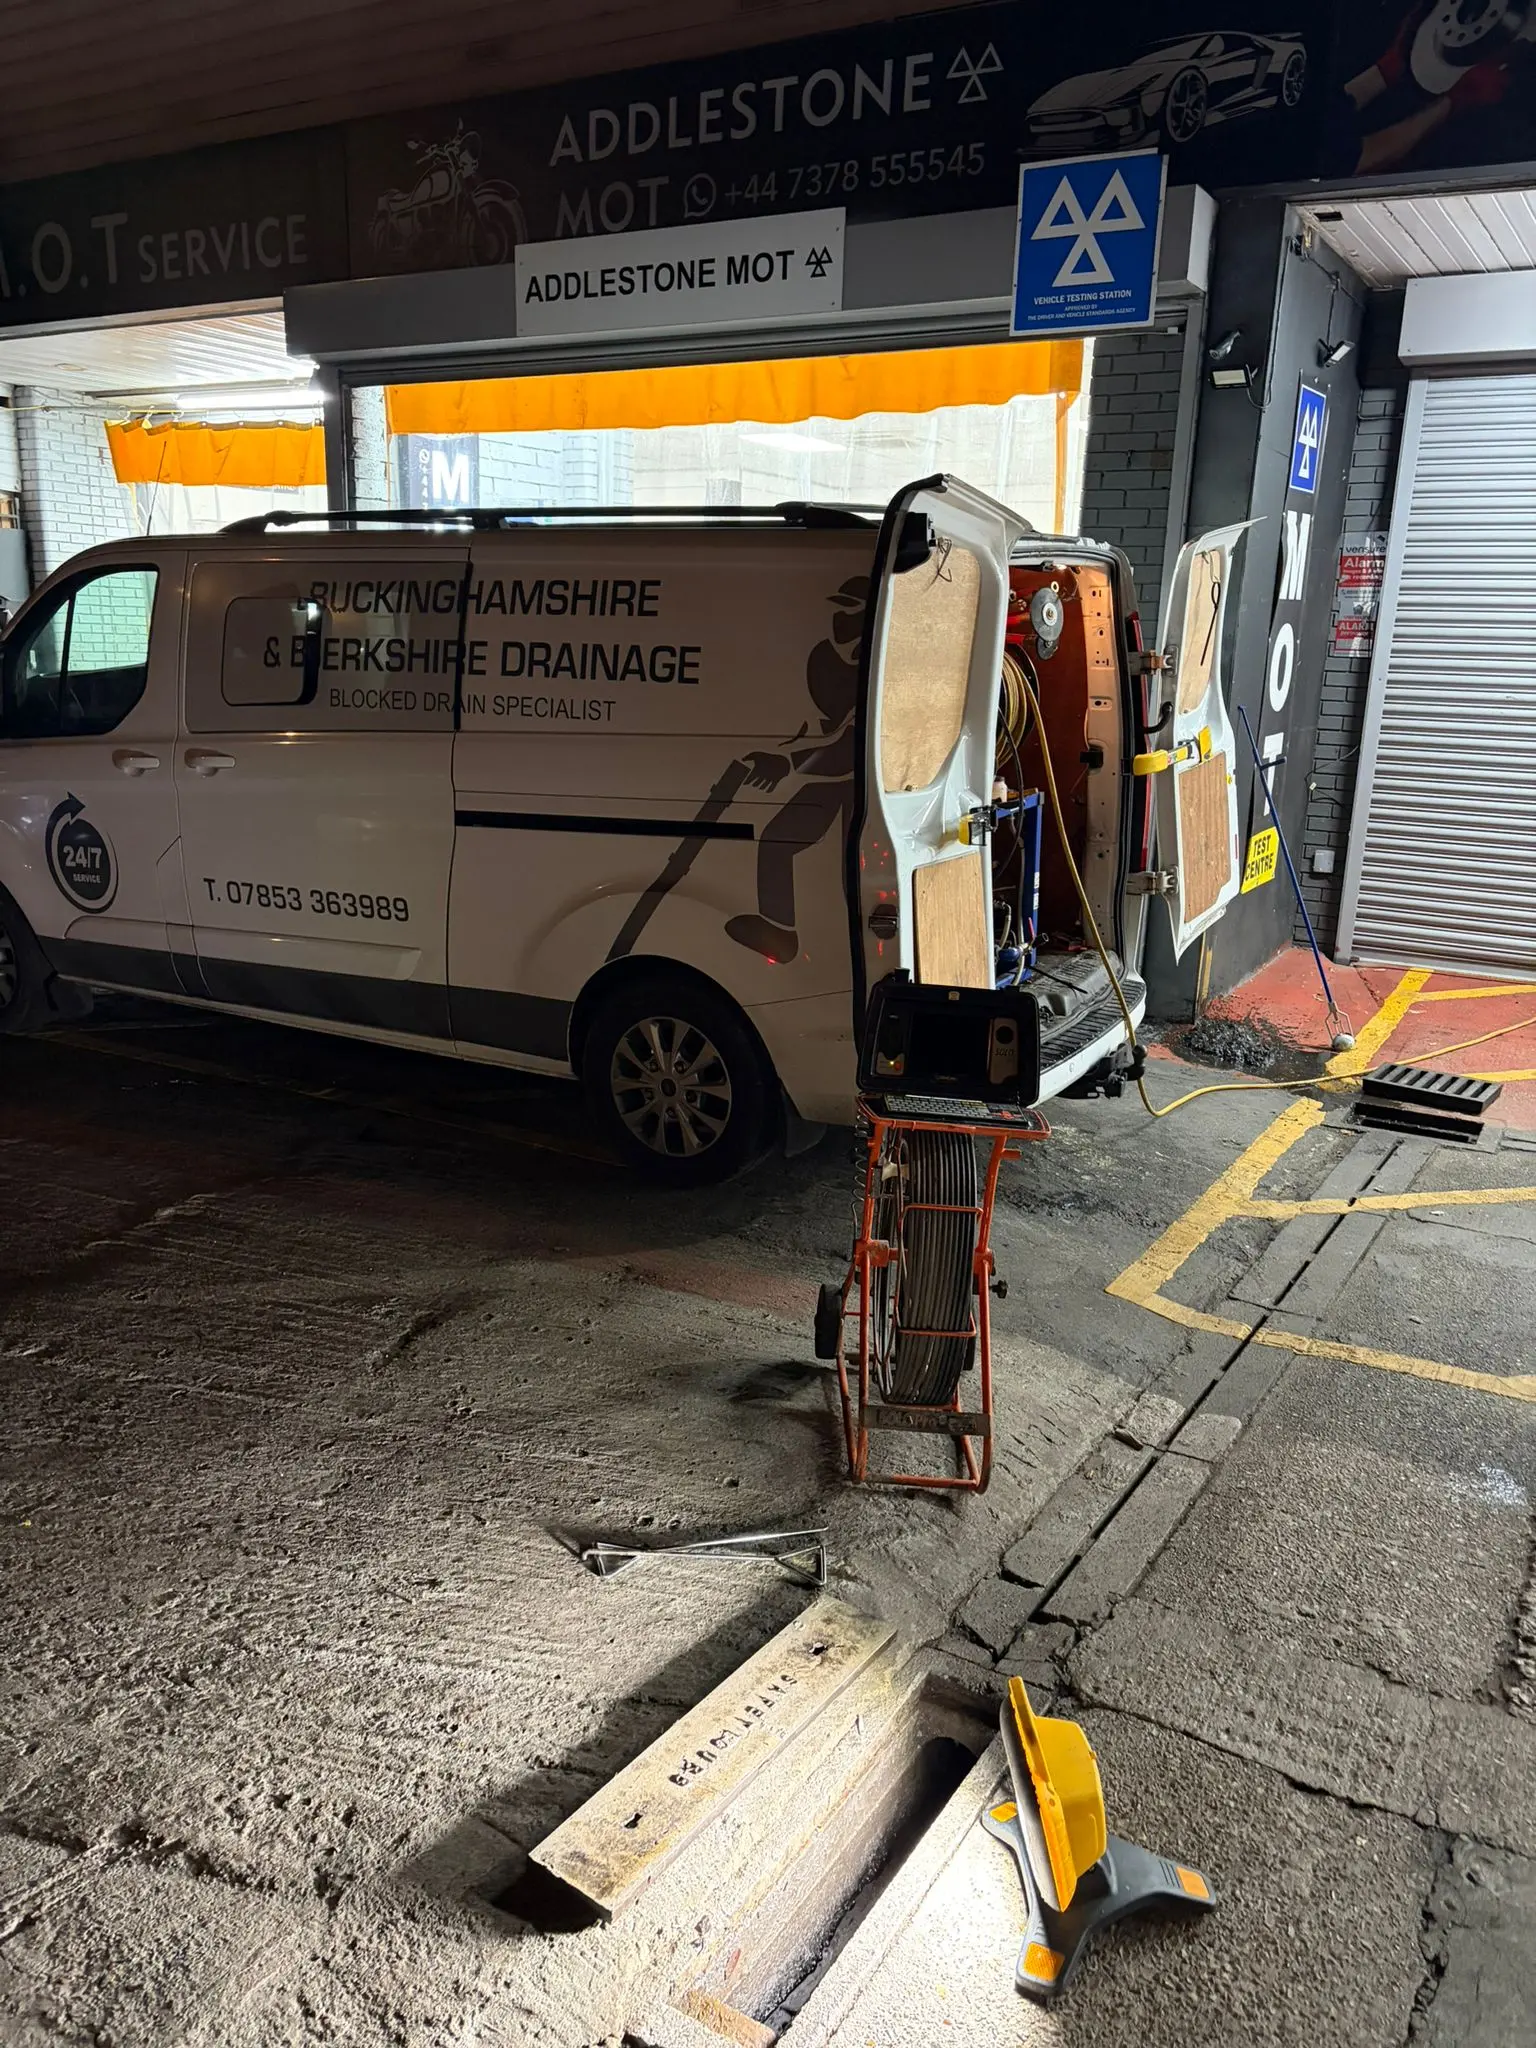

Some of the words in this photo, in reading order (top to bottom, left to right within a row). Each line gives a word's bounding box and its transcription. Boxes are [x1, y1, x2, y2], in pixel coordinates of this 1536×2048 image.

[548, 52, 935, 168] ADDLESTONE
[555, 176, 670, 238] MOT
[725, 170, 779, 207] +44
[788, 160, 860, 200] 7378
[869, 142, 986, 189] 555545
[137, 213, 309, 284] SERVICE
[525, 258, 716, 304] ADDLESTONE
[726, 250, 795, 285] MOT
[1033, 295, 1065, 306] VEHICLE
[1066, 292, 1098, 303] TESTING
[1099, 289, 1132, 300] STATION
[1344, 556, 1385, 568] Alarm
[302, 579, 662, 617] BUCKINGHAMSHIRE
[263, 635, 282, 669] &
[291, 636, 489, 677] BERKSHIRE
[501, 641, 702, 685] DRAINAGE
[329, 688, 417, 711] BLOCKED
[424, 691, 487, 715] DRAIN
[493, 694, 617, 722] SPECIALIST
[63, 845, 102, 869] 24/7
[1252, 834, 1272, 859] TEST
[72, 872, 102, 884] SERVICE
[1244, 853, 1275, 882] CENTRE
[203, 878, 221, 903] T.
[228, 882, 302, 912] 07853
[310, 890, 410, 922] 363989
